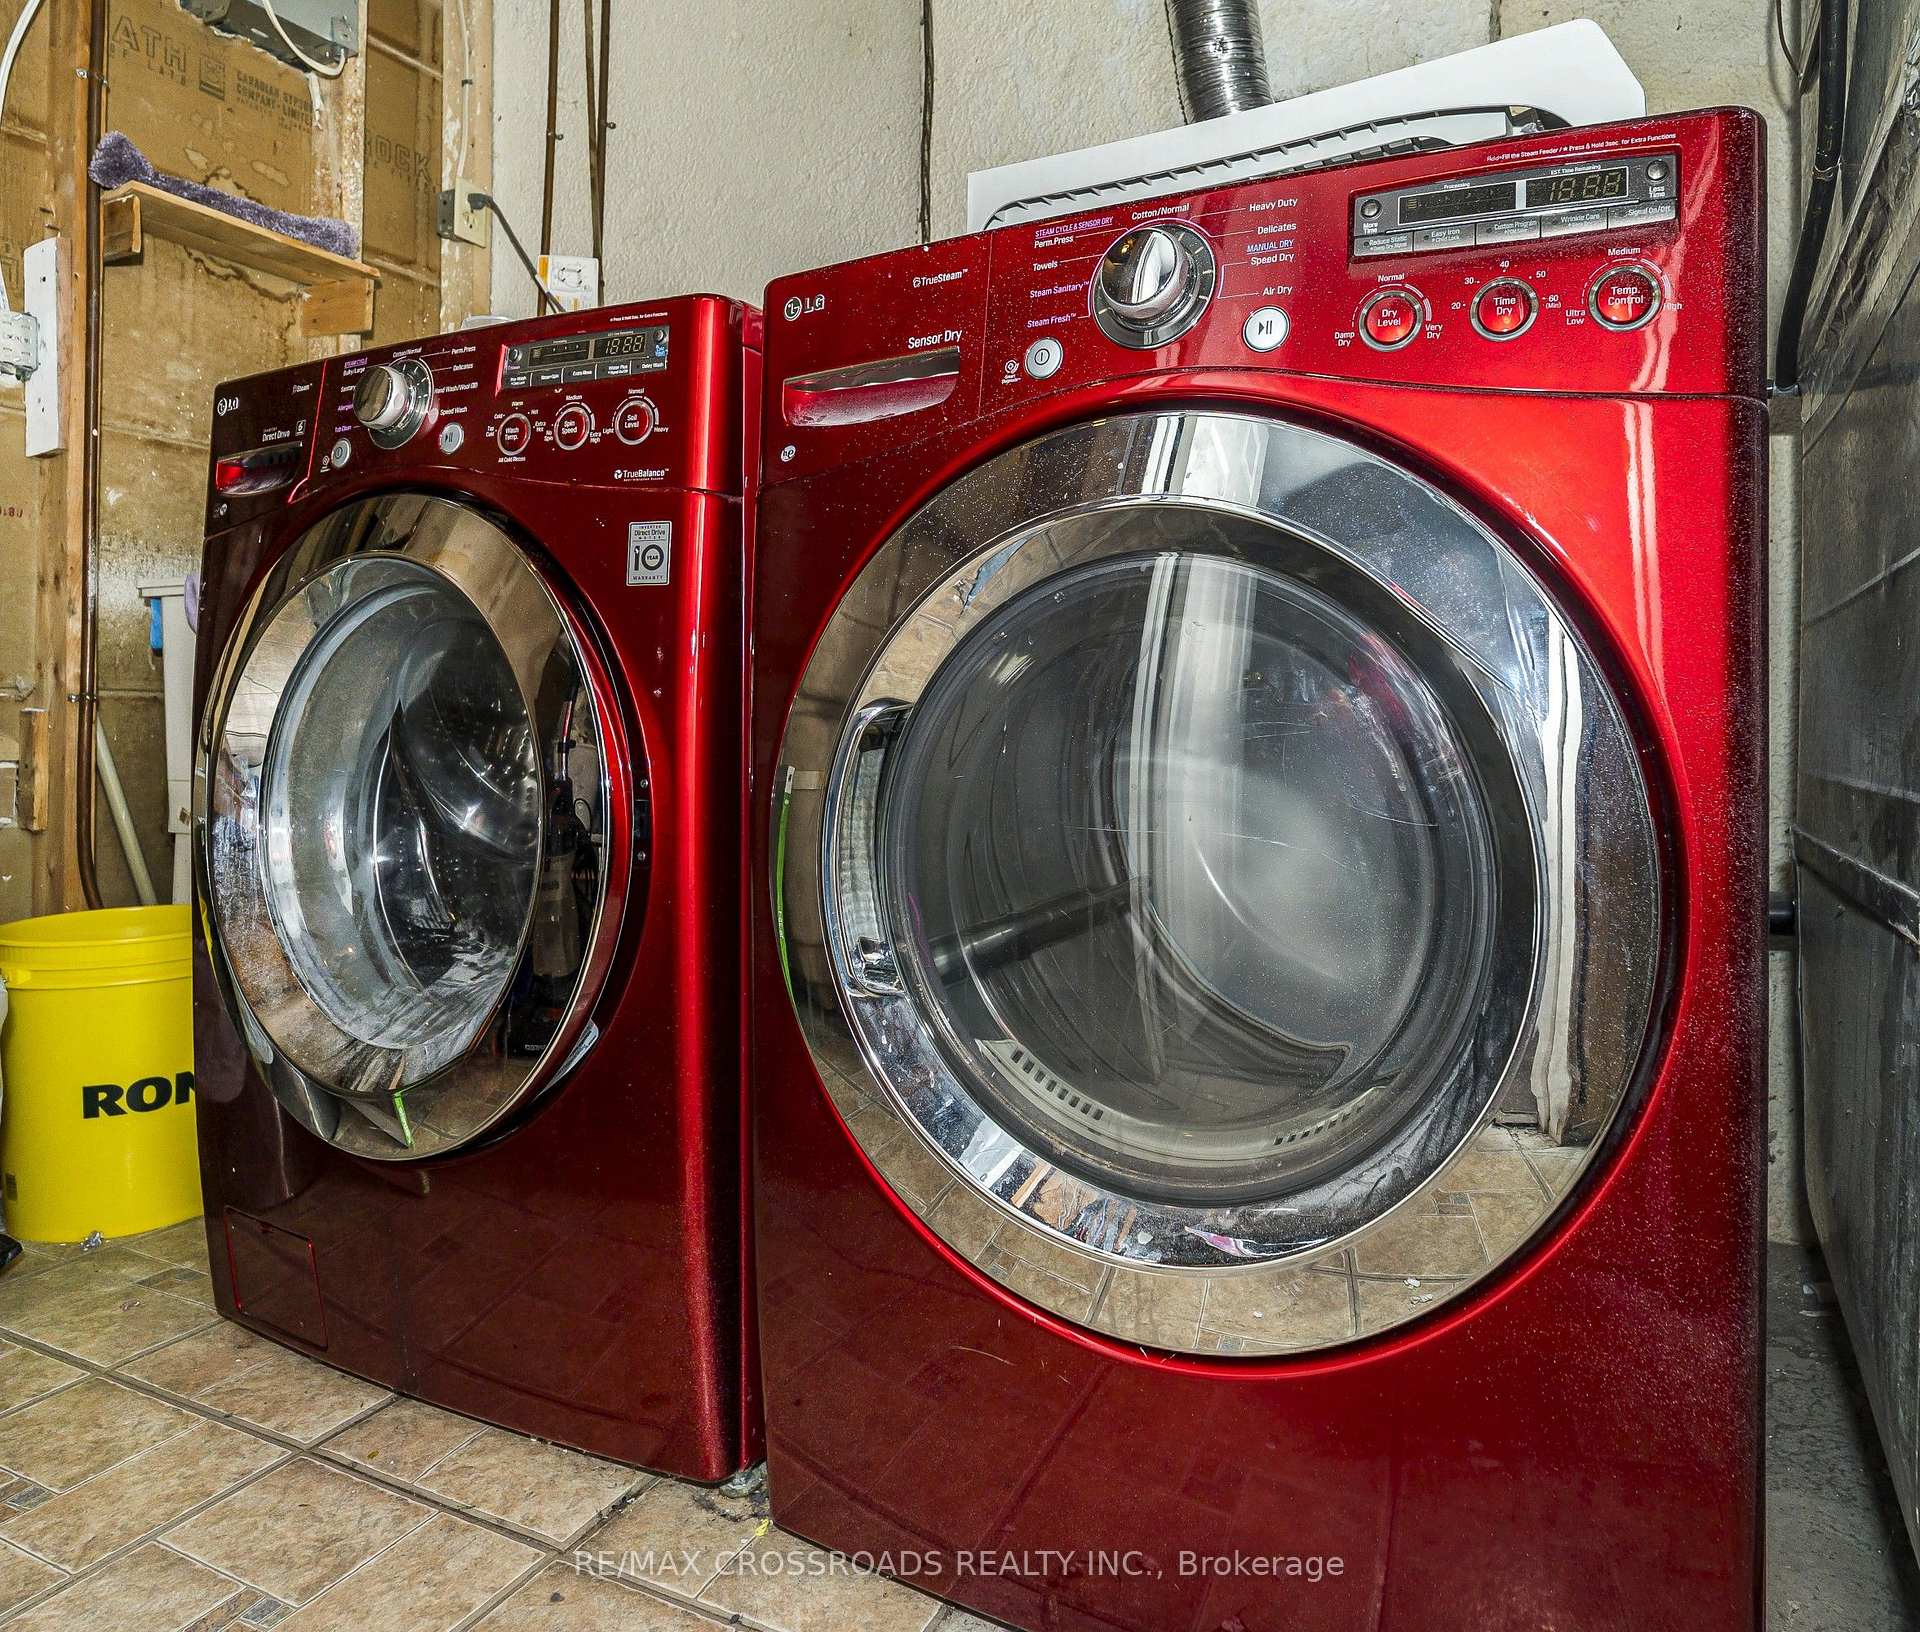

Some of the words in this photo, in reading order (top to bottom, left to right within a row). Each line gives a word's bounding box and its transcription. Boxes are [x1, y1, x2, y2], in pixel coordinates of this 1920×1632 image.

[1647, 133, 1676, 142] Functions
[366, 133, 433, 183] OCK
[1249, 201, 1276, 212] Heavy
[1278, 198, 1298, 208] Duty
[1131, 202, 1190, 220] Cotton/Normal
[1035, 228, 1055, 238] STEAM
[1055, 225, 1073, 234] CYCLE
[1078, 219, 1101, 230] SENSOR
[1101, 216, 1113, 226] DRY
[1257, 223, 1297, 235] Delicates
[1431, 230, 1446, 238] Easy
[1247, 241, 1278, 253] MANUAL
[1279, 239, 1294, 248] DRY
[1608, 246, 1641, 257] Medium
[1250, 254, 1277, 266] Speed
[1279, 253, 1295, 263] Dry
[1499, 260, 1510, 268] 40
[1033, 260, 1058, 271] Towels
[1377, 273, 1405, 283] Normal
[1536, 270, 1546, 278] 50
[1464, 277, 1474, 285] 30
[1030, 288, 1053, 299] Steam
[1263, 287, 1276, 296] Air
[1277, 285, 1293, 295] Dry
[1611, 286, 1640, 295] Temp.
[1493, 296, 1516, 306] Time
[1548, 294, 1559, 302] 60
[1607, 295, 1644, 306] Control
[1451, 302, 1461, 310] 20
[1381, 309, 1397, 318] Dry
[1496, 306, 1513, 316] Dry
[1565, 309, 1586, 317] Ultra
[1027, 319, 1050, 328] Steam
[1377, 318, 1401, 327] Level
[1566, 317, 1585, 325] Low
[1425, 323, 1443, 332] Very
[908, 333, 943, 349] Sensor
[944, 330, 962, 343] Dry
[1334, 331, 1355, 341] Damp
[1427, 331, 1441, 340] Dry
[1338, 339, 1351, 347] Dry
[563, 420, 575, 428] Spin
[624, 421, 640, 429] Level
[561, 427, 577, 435] Speed
